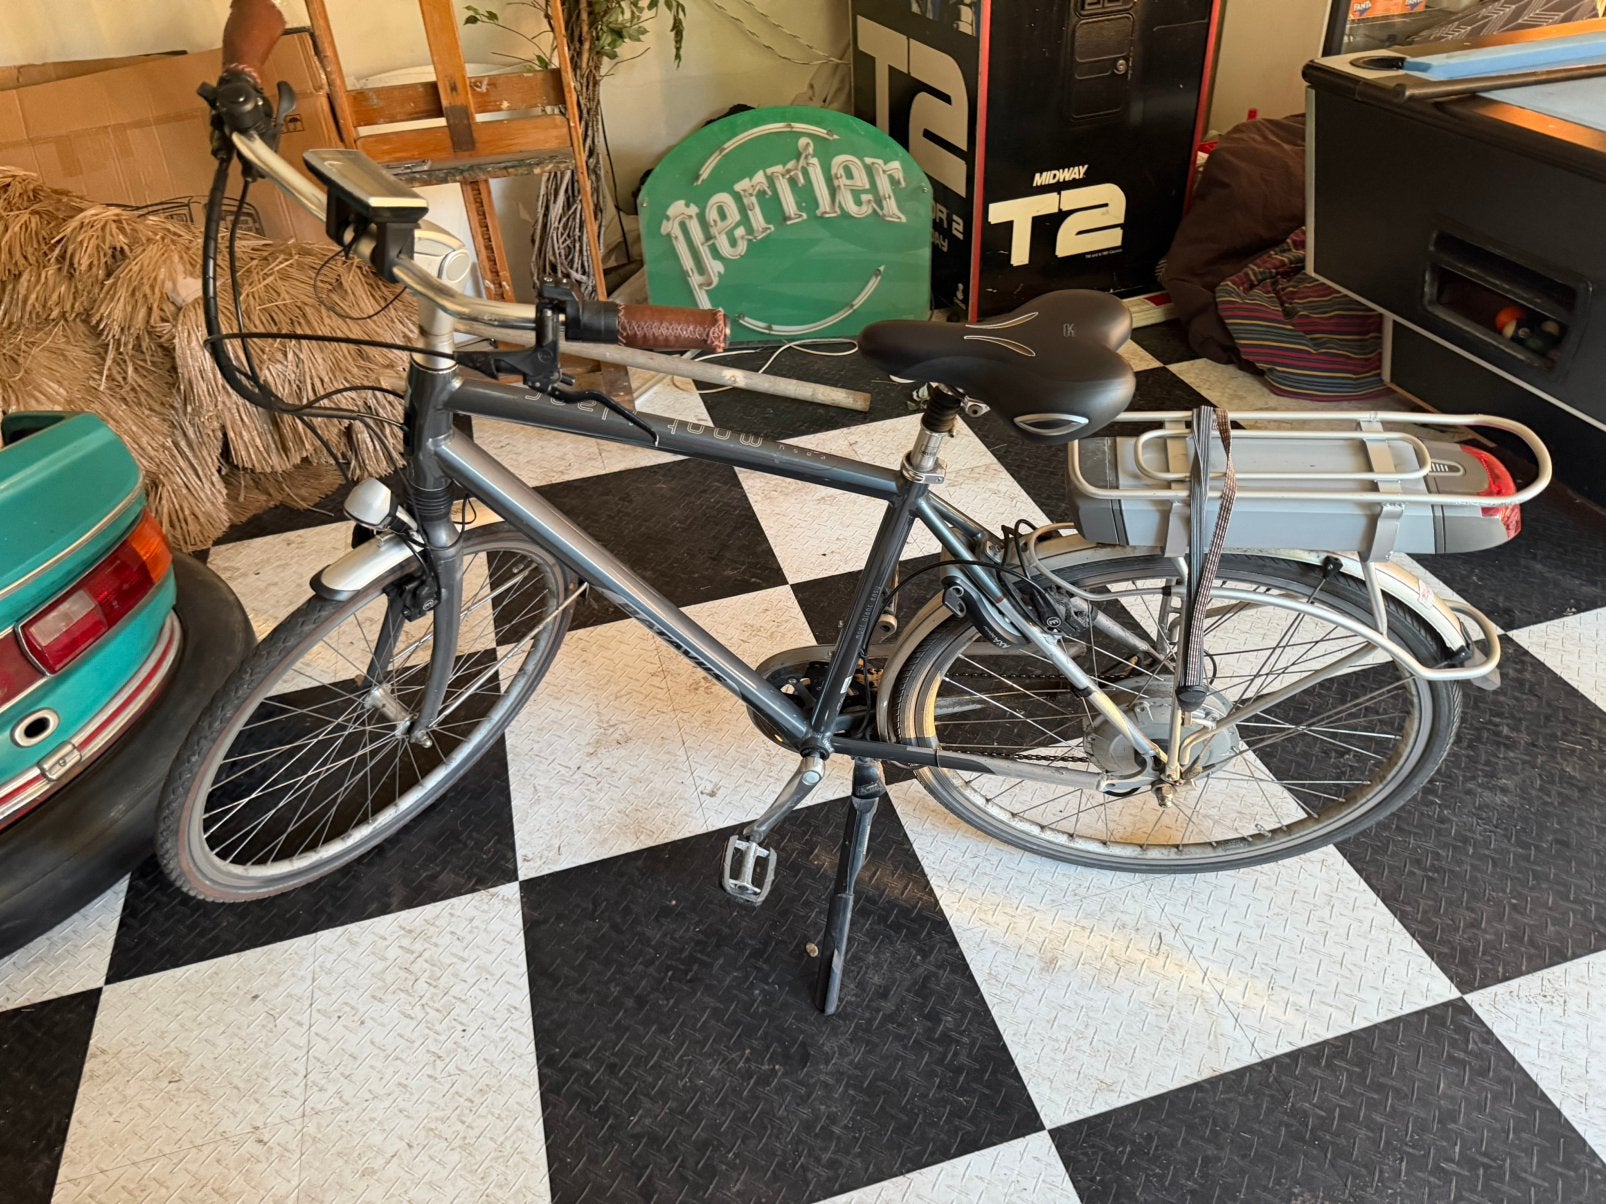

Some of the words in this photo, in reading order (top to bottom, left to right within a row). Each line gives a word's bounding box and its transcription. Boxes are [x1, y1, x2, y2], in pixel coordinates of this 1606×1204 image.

[857, 15, 969, 198] T2
[1032, 164, 1088, 187] MIDWAY
[660, 137, 907, 311] Perrier
[951, 213, 965, 241] 2
[988, 183, 1127, 267] T2
